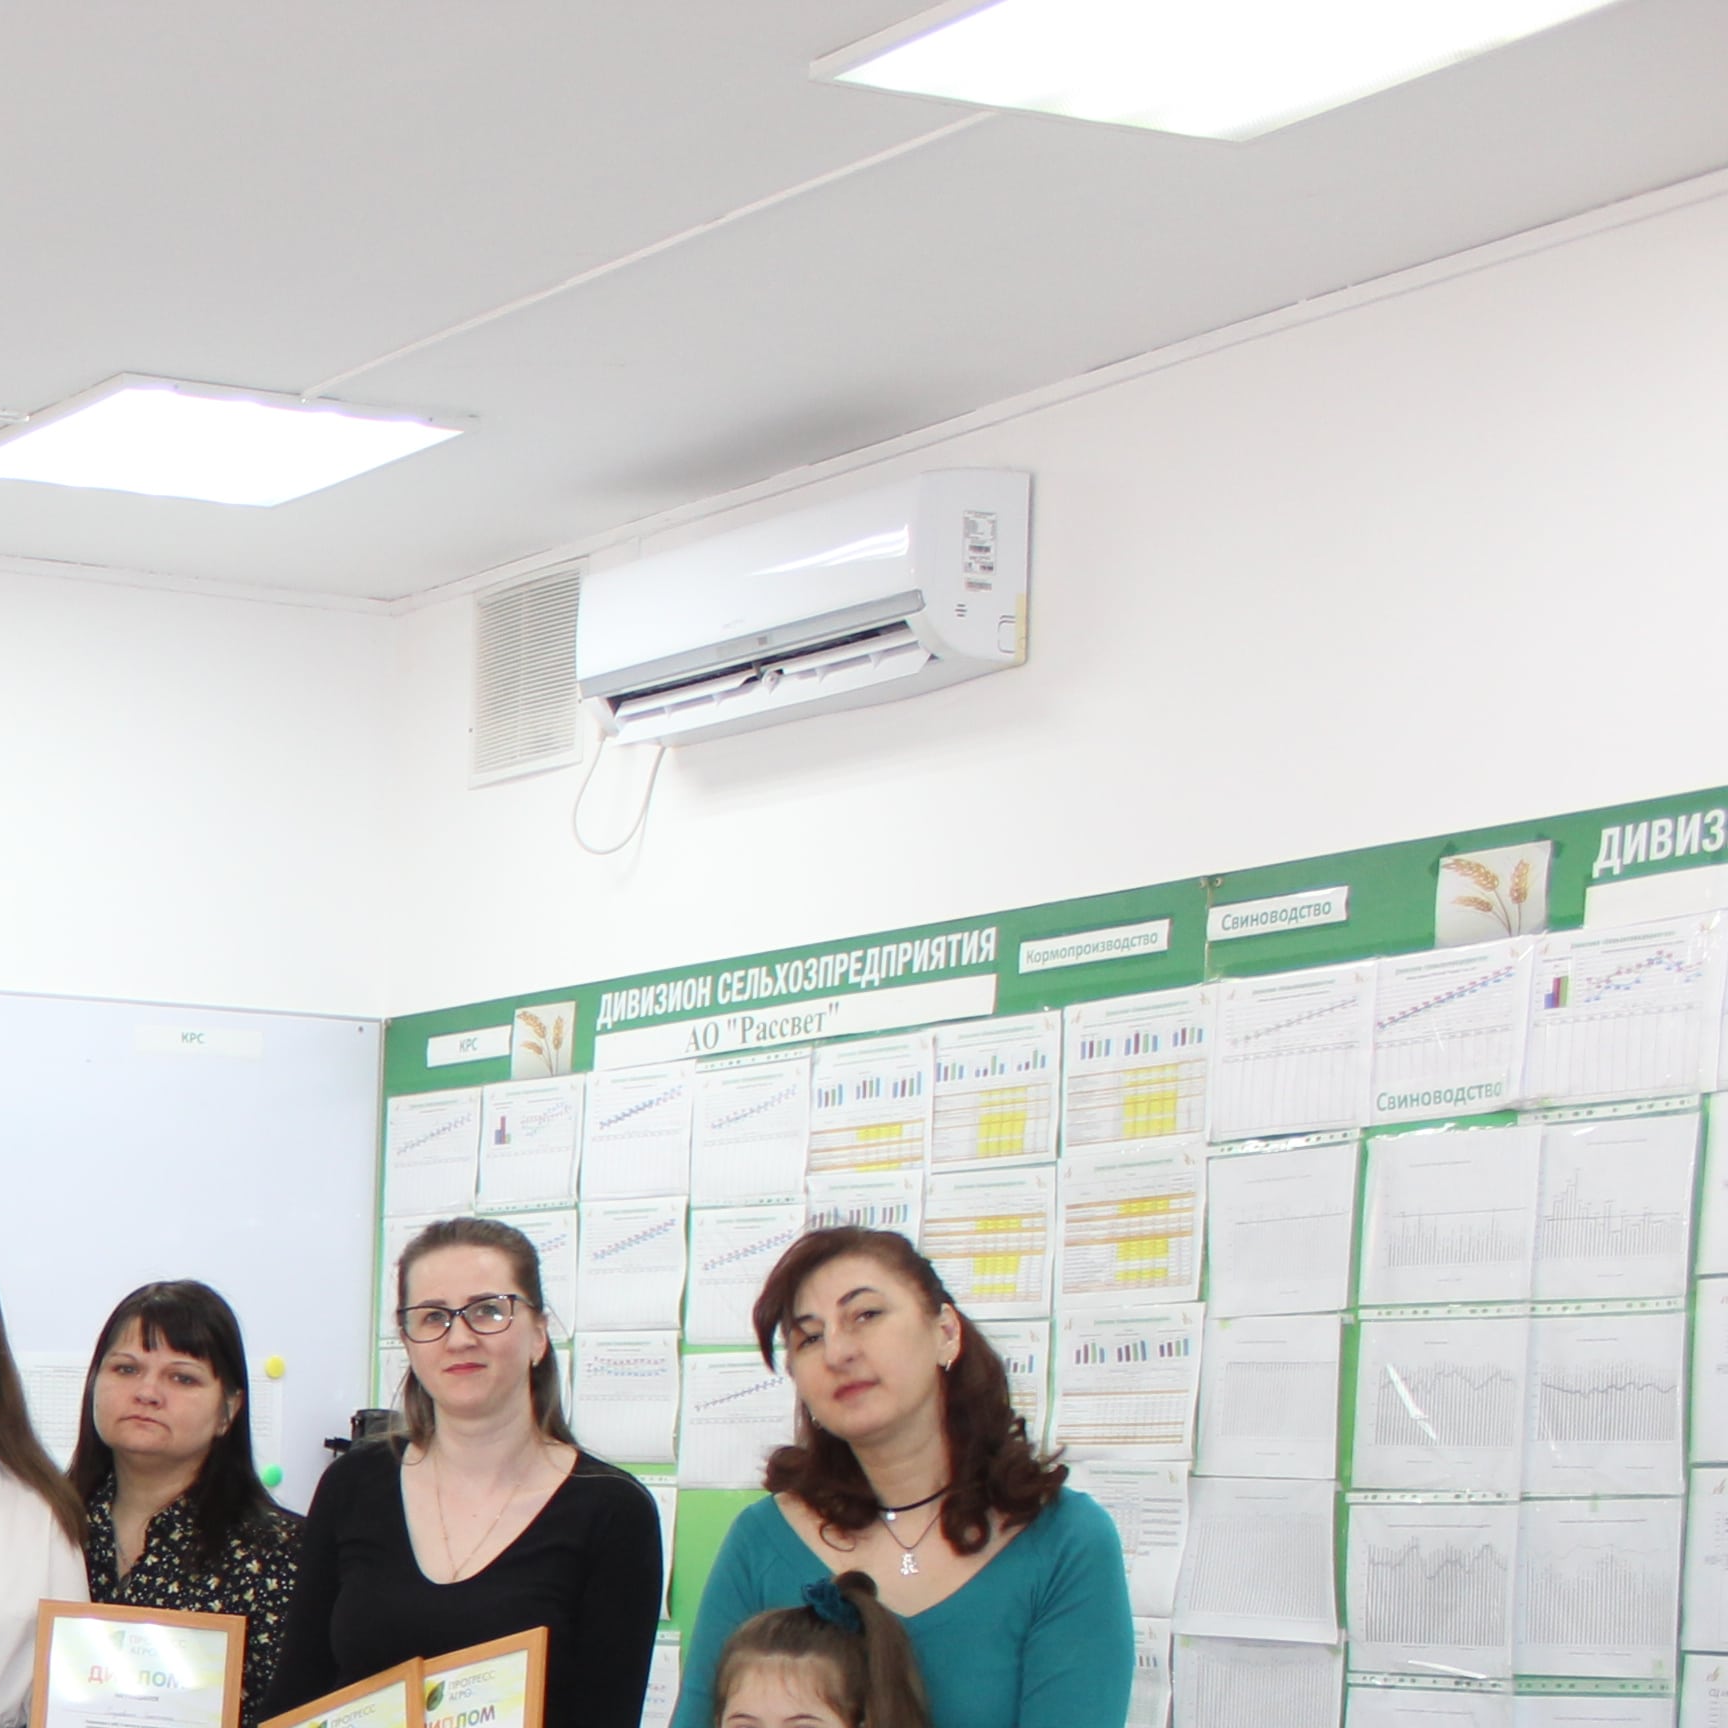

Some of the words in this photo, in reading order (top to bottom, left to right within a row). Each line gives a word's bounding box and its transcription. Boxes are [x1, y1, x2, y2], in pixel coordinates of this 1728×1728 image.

[1221, 899, 1333, 934] Свиноводство
[1025, 928, 1160, 966] Кормопроизводство
[596, 976, 712, 1029] ДИВИЗИОН
[716, 926, 997, 1008] СЕЛЬХОЗПРЕДПРИЯТИЯ
[181, 1031, 206, 1046] КРС
[684, 1023, 720, 1054] АО
[727, 1001, 840, 1047] "Рассвет"
[458, 1037, 479, 1055] КРС
[1375, 1080, 1504, 1114] Свиноводство
